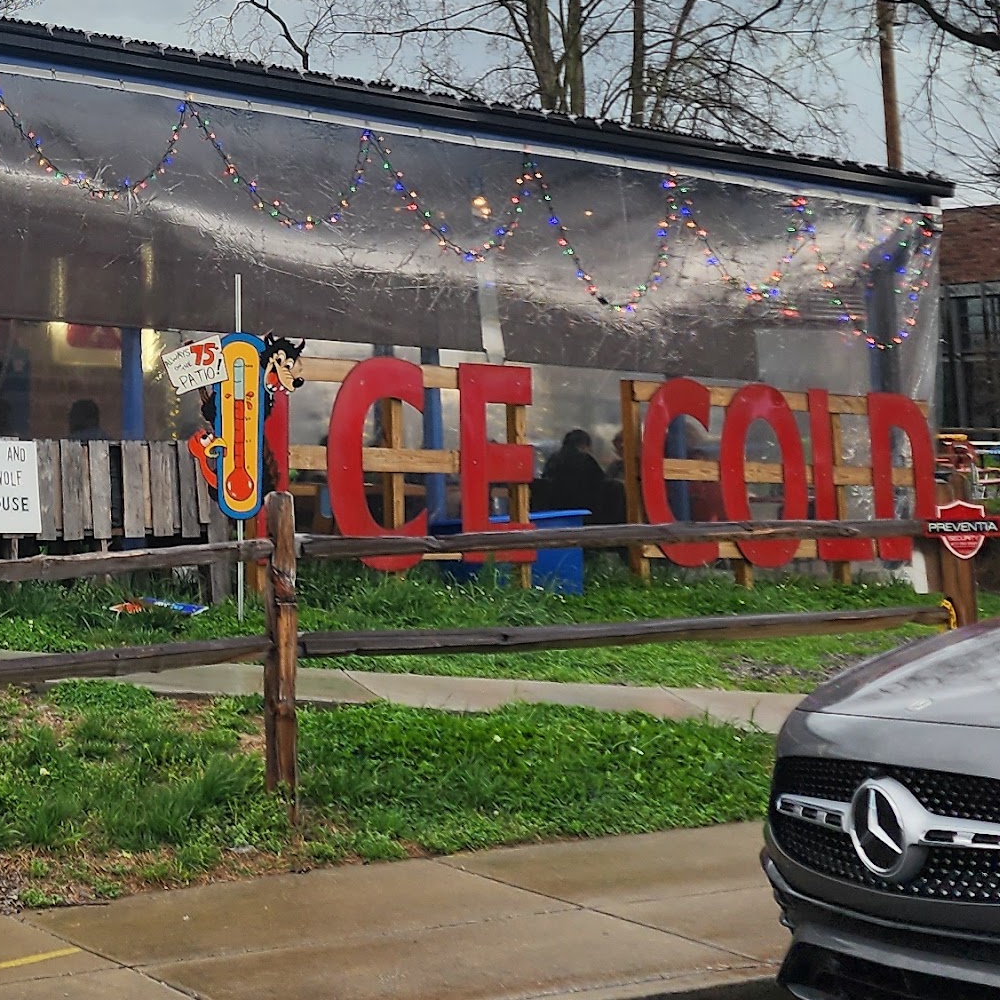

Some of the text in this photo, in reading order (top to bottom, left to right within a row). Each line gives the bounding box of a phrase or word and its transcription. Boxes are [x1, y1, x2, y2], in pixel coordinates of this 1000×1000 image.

[164, 347, 190, 368] ALWAYS
[6, 445, 26, 463] AND
[640, 377, 936, 568] COLD
[928, 521, 999, 533] PREVENTIA
